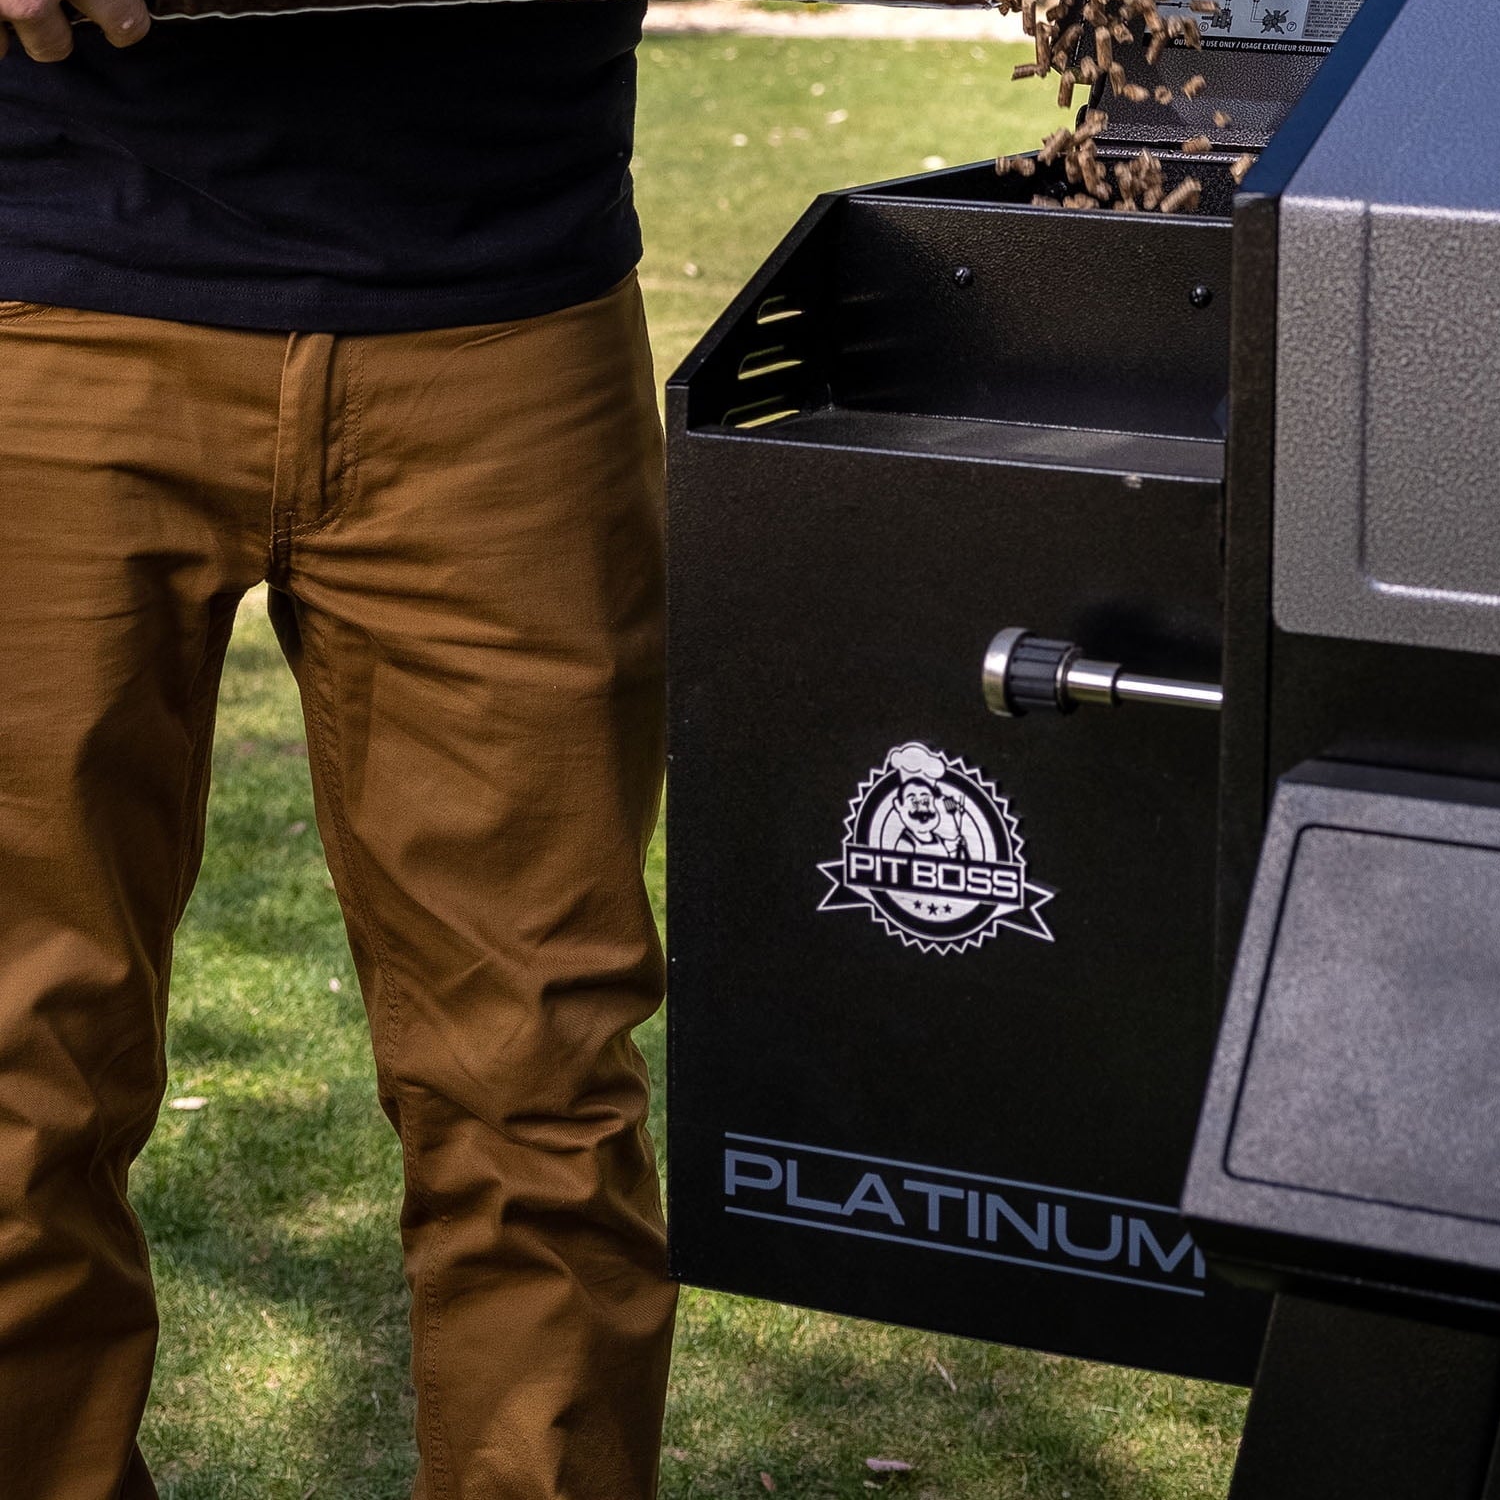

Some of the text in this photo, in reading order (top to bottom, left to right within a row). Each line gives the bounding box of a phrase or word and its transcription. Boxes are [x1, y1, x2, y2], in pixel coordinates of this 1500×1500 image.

[1174, 38, 1205, 46] OUTR
[1262, 42, 1297, 51] EXTÉRIEUR
[1298, 45, 1333, 53] SEULEMEN
[850, 853, 1018, 898] PIT BOSS
[725, 1149, 1206, 1279] PLATINUM
